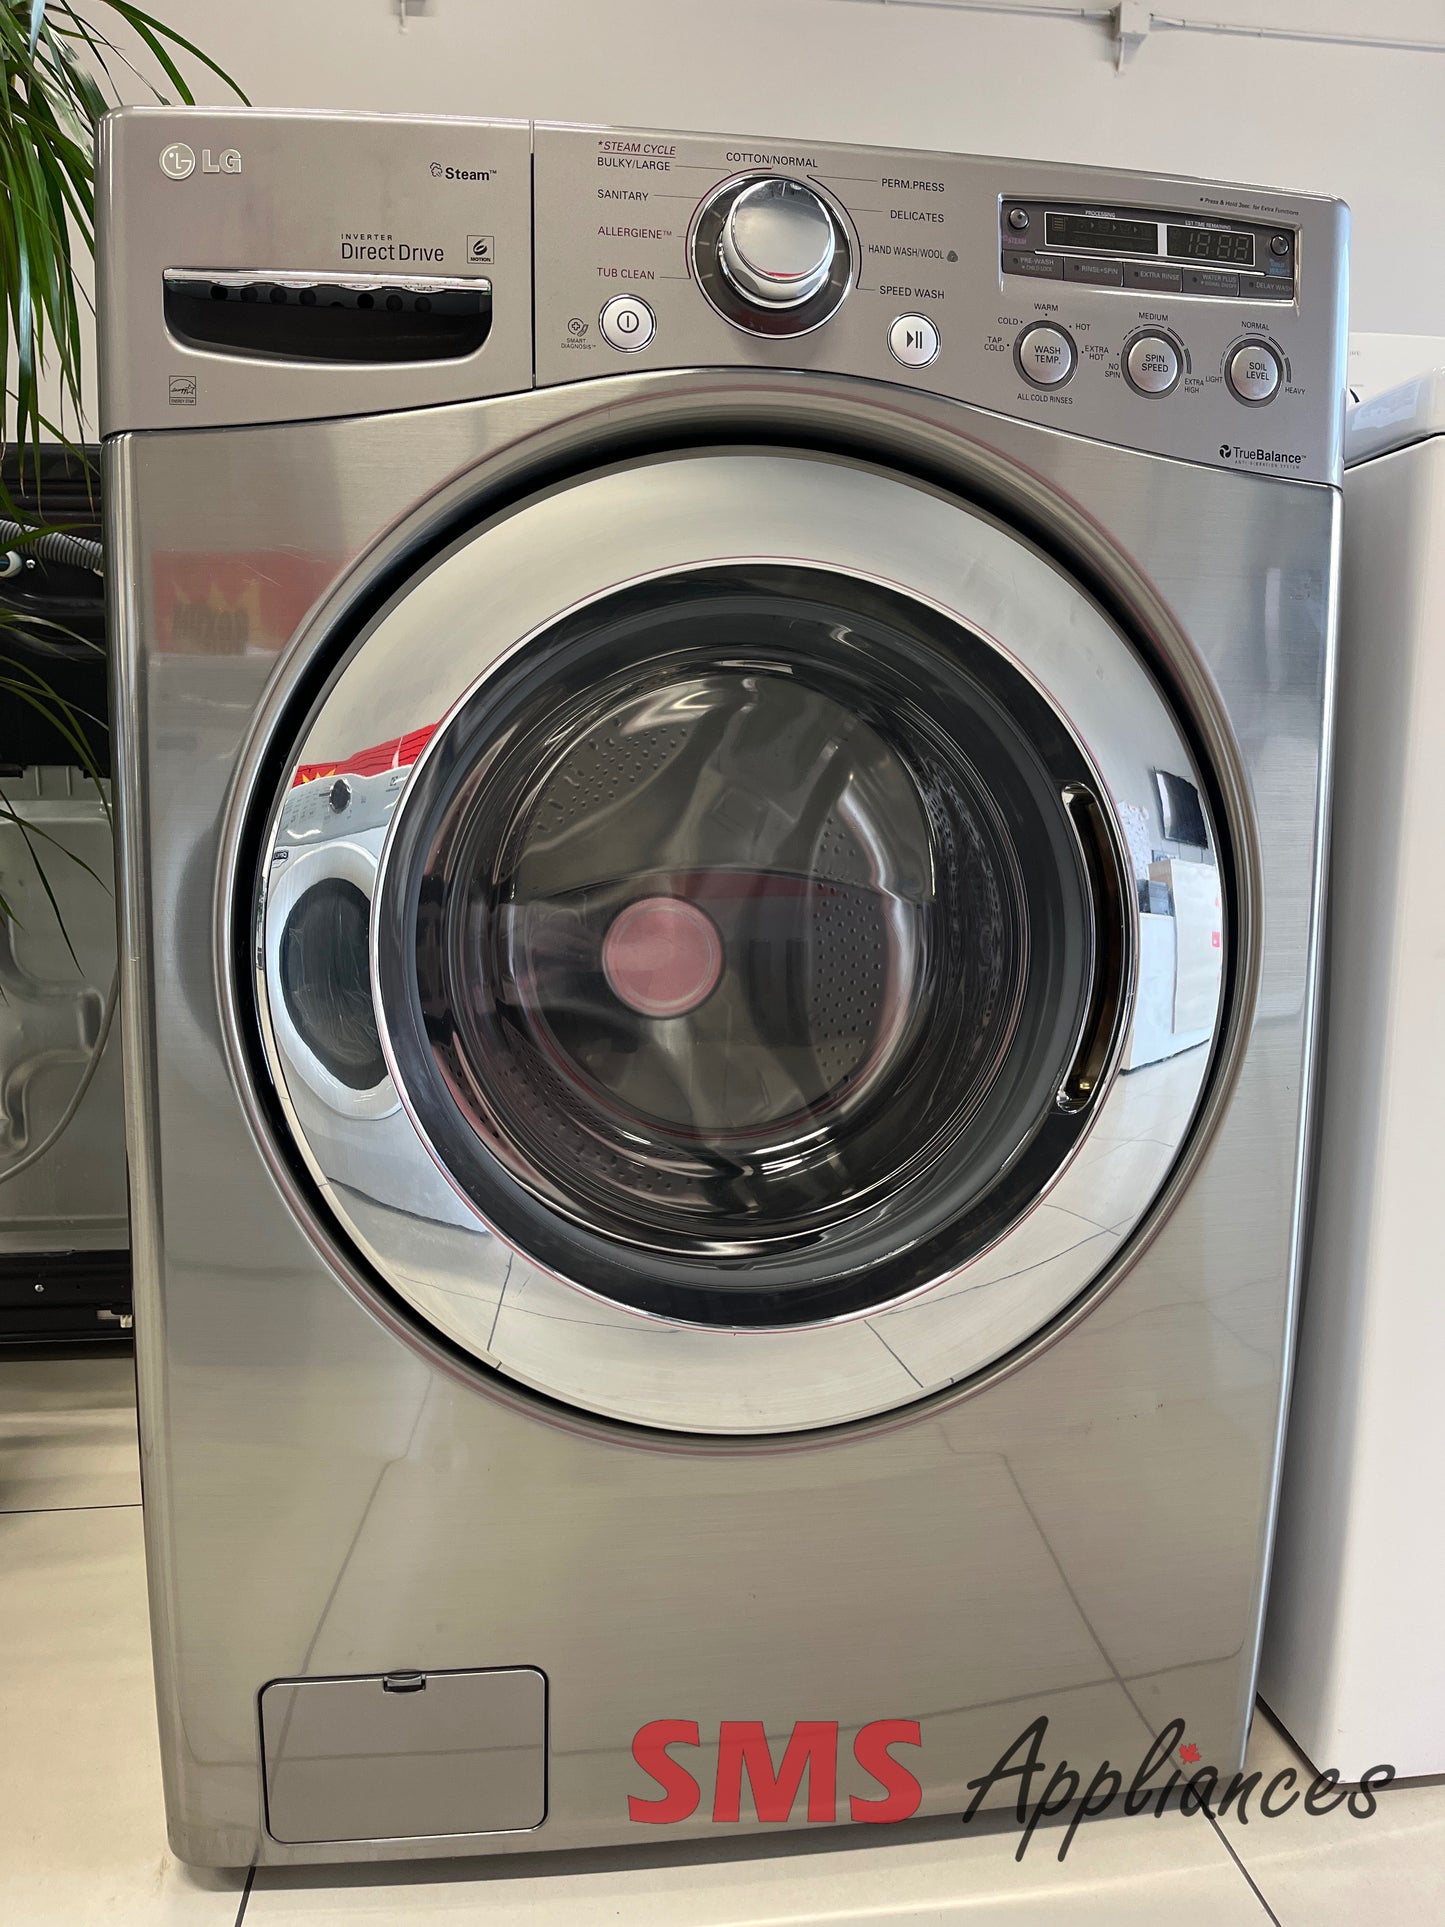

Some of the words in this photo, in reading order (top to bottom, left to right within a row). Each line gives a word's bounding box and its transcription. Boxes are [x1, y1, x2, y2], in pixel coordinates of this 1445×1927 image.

[643, 144, 677, 155] CYCLE
[202, 149, 242, 174] LG
[597, 157, 671, 171] BULKY/LARGE
[726, 152, 818, 168] COTTON/NORMAL
[881, 178, 945, 192] PERM.PRESS
[597, 189, 649, 201] SANITARY
[890, 209, 945, 223] DELICATES
[1274, 207, 1300, 216] Functions
[341, 243, 395, 261] Direct
[399, 244, 444, 261] Drive
[868, 244, 892, 255] HAND
[893, 246, 945, 260] WASH/WOOL
[597, 267, 618, 278] TUB
[621, 269, 655, 280] CLEAN
[1140, 270, 1160, 279] EXTRA
[1161, 272, 1181, 281] RINSE
[1202, 274, 1222, 282] WATER
[1256, 282, 1276, 290] DELAY
[879, 285, 912, 297] SPEED
[914, 288, 945, 299] WASH
[1034, 303, 1059, 312] WARM
[997, 317, 1019, 325] COLD
[1138, 312, 1169, 321] MEDIUM
[1075, 323, 1091, 331] HOT
[1241, 321, 1270, 331] NORMAL
[987, 336, 1002, 344] TAP
[984, 344, 1005, 352] COLD
[1034, 345, 1061, 355] WASH
[1085, 345, 1109, 354] EXTRA
[1034, 354, 1061, 365] TEMP.
[1089, 353, 1105, 361] HOT
[1145, 354, 1165, 363] SPIN
[1108, 363, 1120, 371] NO
[1141, 362, 1169, 373] SPEED
[1249, 362, 1268, 371] SOIL
[1104, 370, 1121, 378] SPIN
[1246, 371, 1270, 381] LEVEL
[1184, 377, 1205, 386] EXTRA
[1205, 376, 1223, 384] LIGHT
[1184, 386, 1200, 394] HIGH
[1284, 386, 1306, 396] HEAVY
[1017, 393, 1029, 401] ALL
[1030, 394, 1049, 403] COLD
[1050, 396, 1073, 405] RINSES
